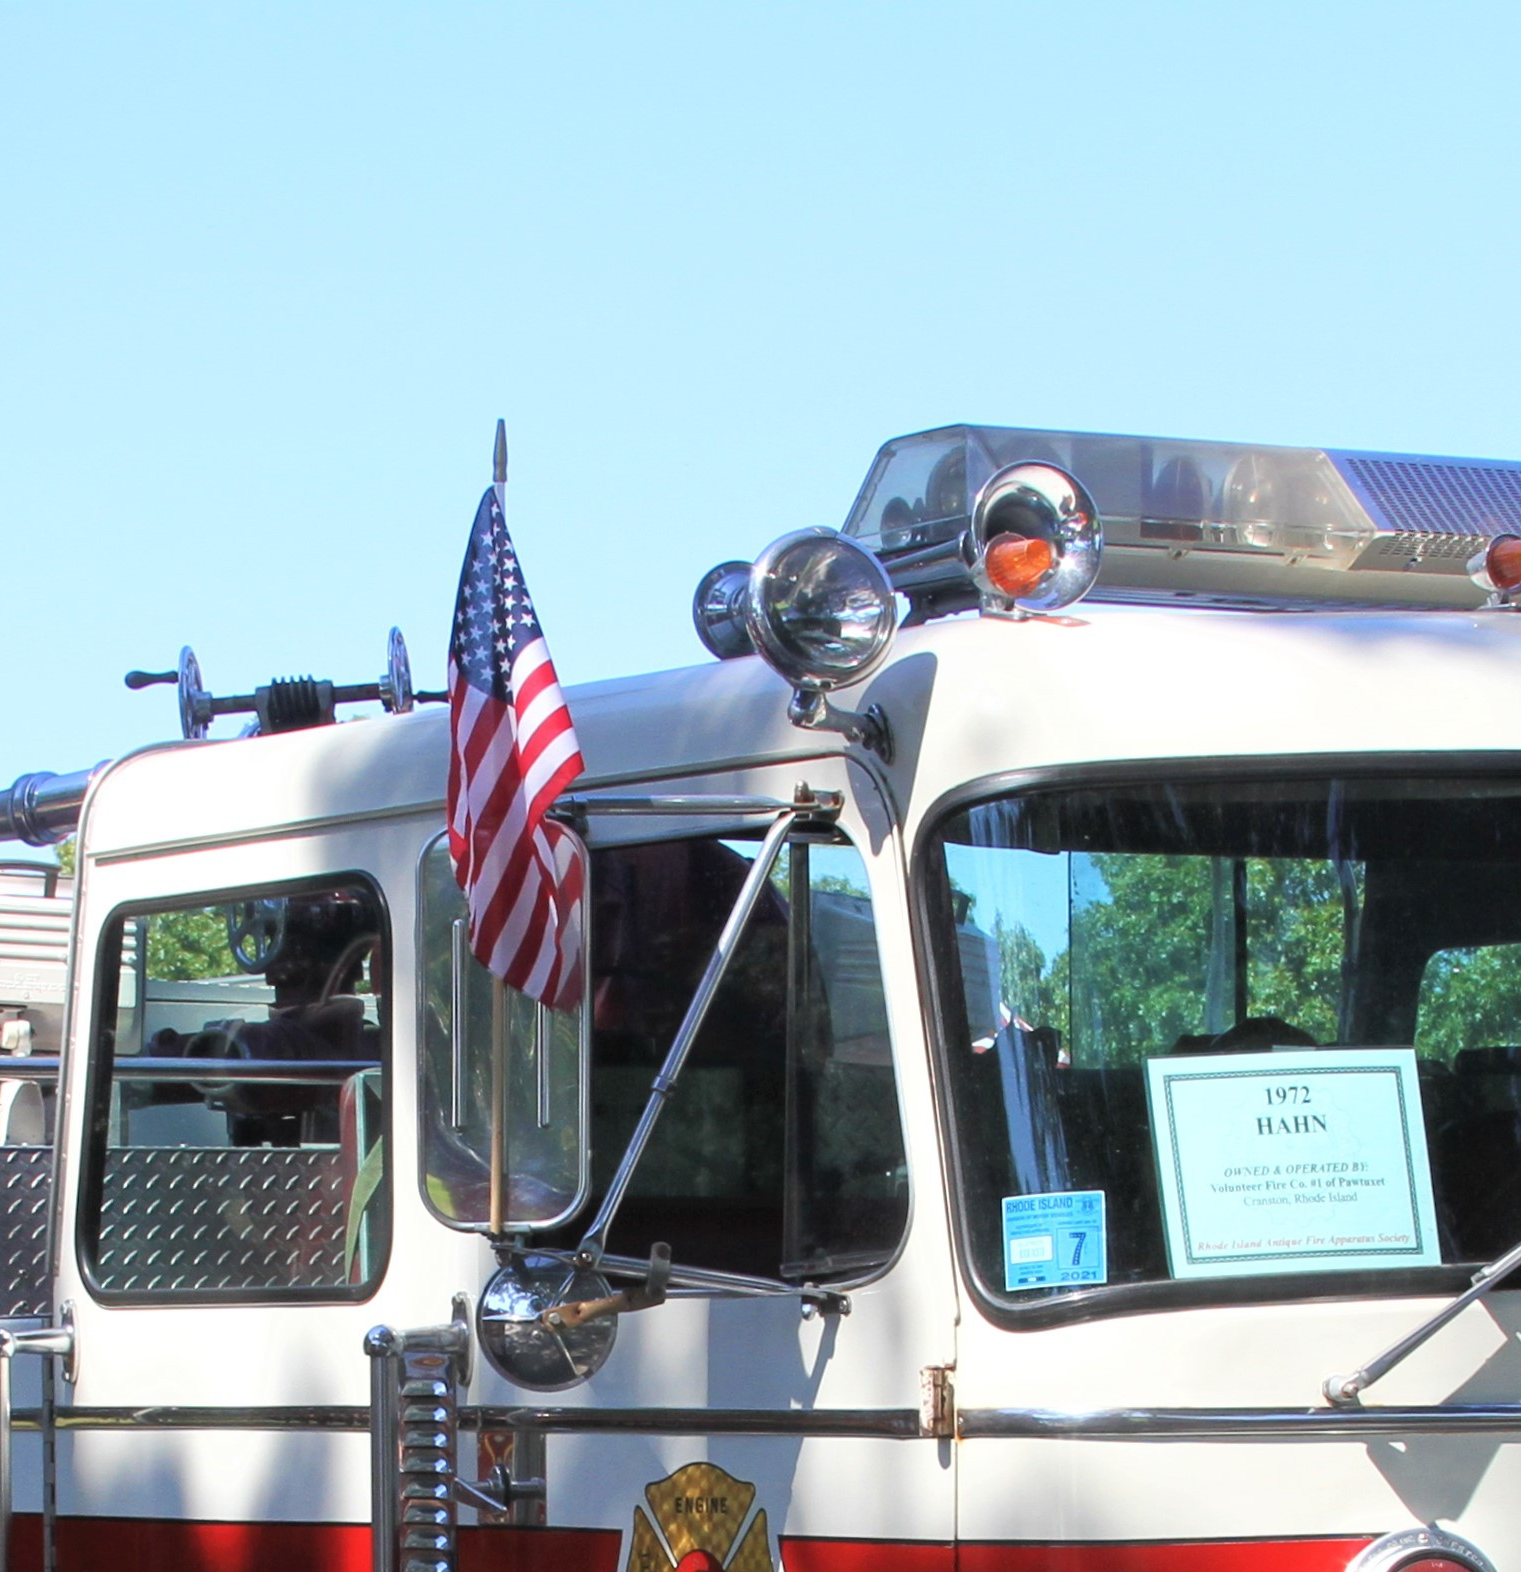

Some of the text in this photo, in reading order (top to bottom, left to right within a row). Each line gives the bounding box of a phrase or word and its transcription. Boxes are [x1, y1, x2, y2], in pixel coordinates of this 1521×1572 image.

[1264, 1086, 1312, 1105] 1972
[1255, 1114, 1328, 1136] HAHN
[1223, 1166, 1270, 1178] OWNED
[1273, 1166, 1282, 1176] &
[1285, 1162, 1349, 1175] OPERATED
[1210, 1182, 1262, 1194] Volunteer
[1265, 1180, 1287, 1192] Fire
[1289, 1179, 1308, 1190] Co.
[1325, 1177, 1336, 1188] of
[1338, 1176, 1386, 1188] Pawtuxet
[1006, 1197, 1074, 1213] RHODE ISLAND
[1294, 1193, 1326, 1205] Rhode
[1328, 1191, 1358, 1203] Island
[1068, 1232, 1087, 1266] 7
[1197, 1231, 1411, 1252] Rhode Island Antique Fire Apparatus Society
[1060, 1270, 1098, 1281] 2021
[674, 1496, 729, 1515] ENGINE
